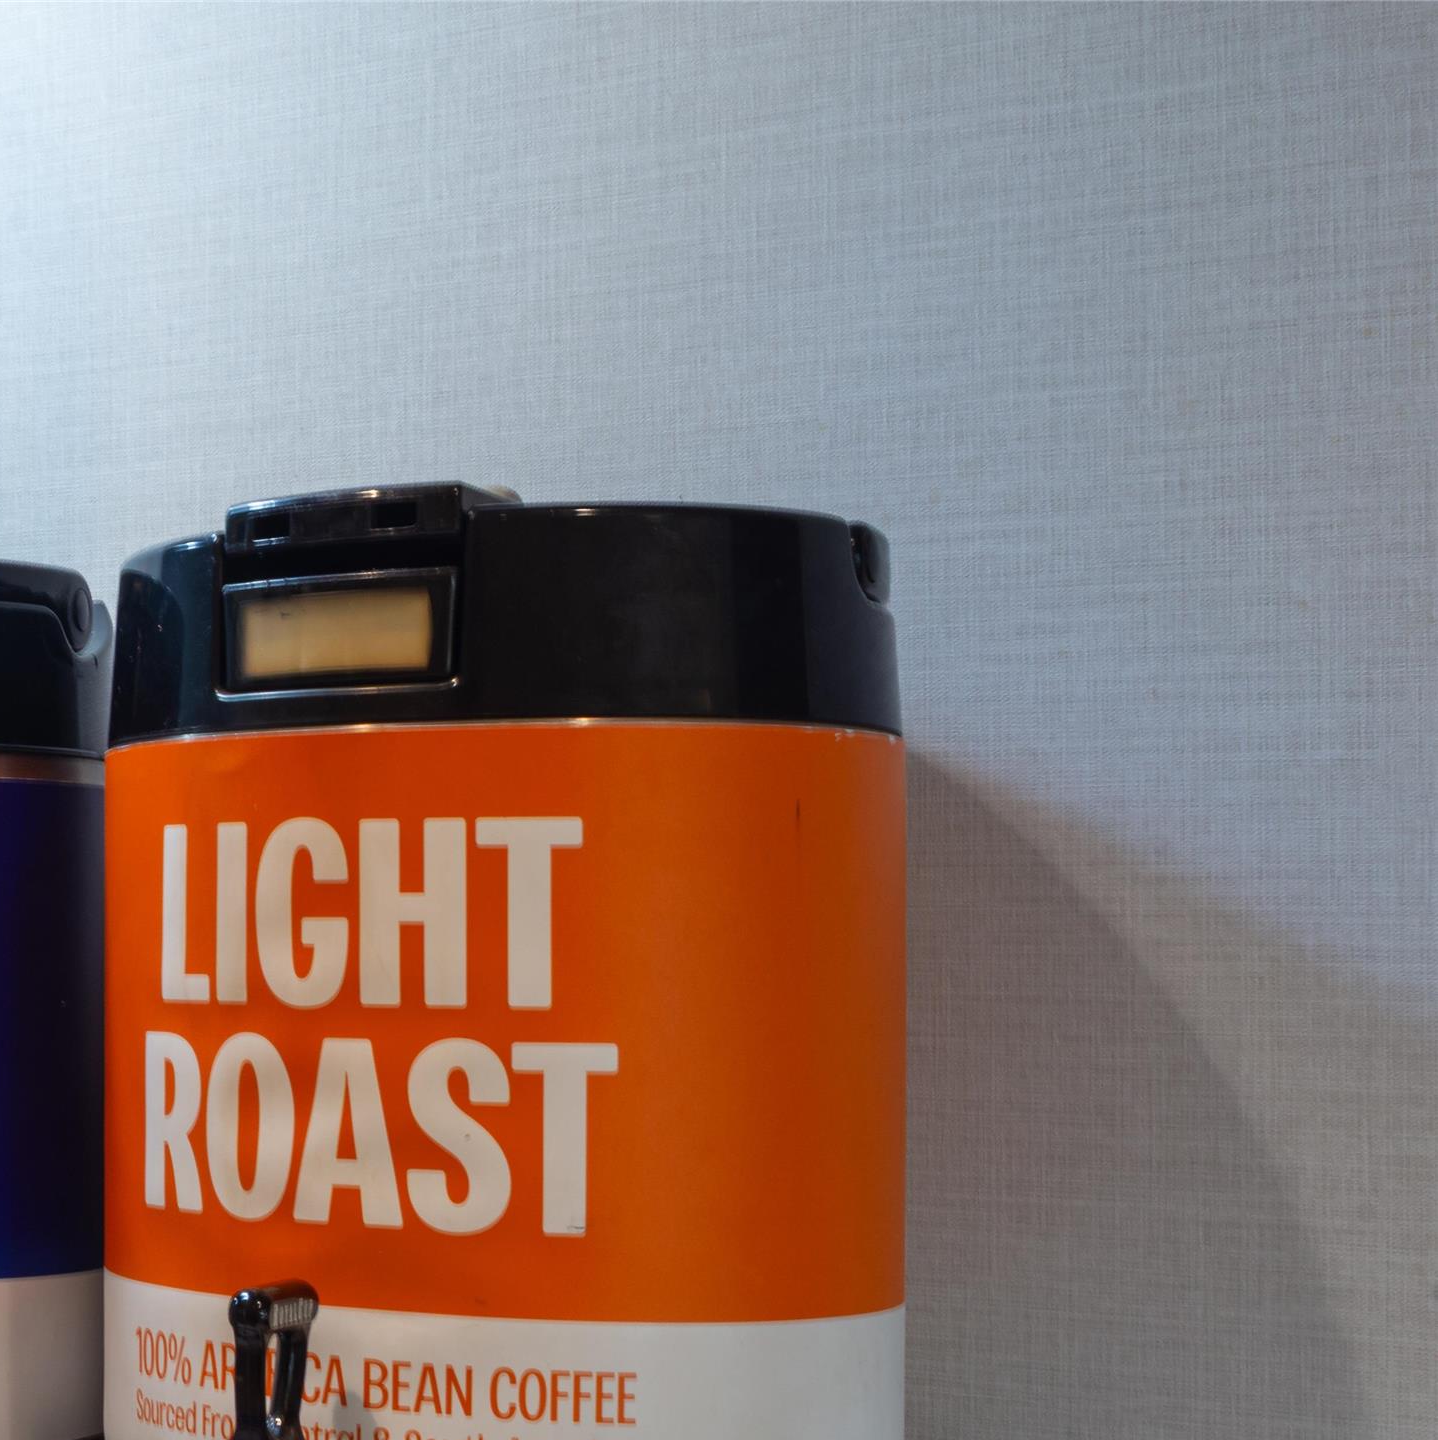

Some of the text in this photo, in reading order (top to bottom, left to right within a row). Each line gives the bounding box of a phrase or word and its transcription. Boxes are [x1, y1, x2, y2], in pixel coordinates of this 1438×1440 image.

[160, 816, 584, 1011] LIGHT
[144, 1030, 620, 1237] ROAST
[135, 1326, 193, 1386] 100%
[362, 1357, 474, 1418] BEAN
[489, 1365, 638, 1425] COFFEE
[135, 1388, 198, 1436] Sourced
[202, 1403, 236, 1440] Fro
